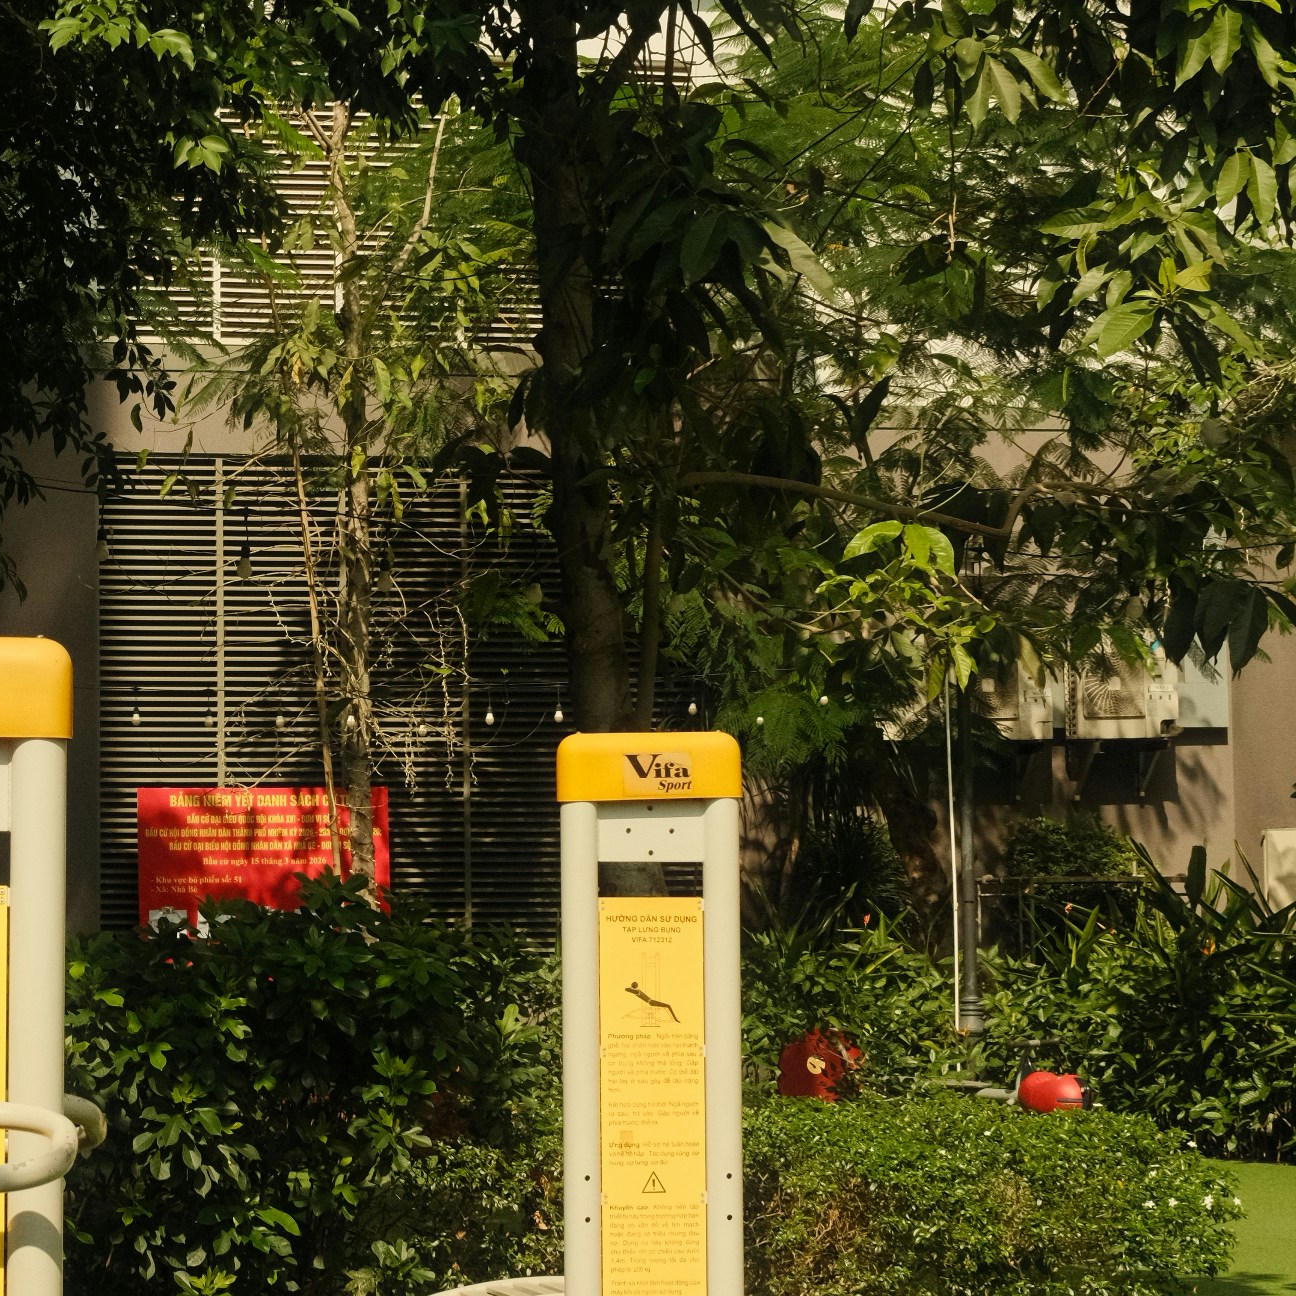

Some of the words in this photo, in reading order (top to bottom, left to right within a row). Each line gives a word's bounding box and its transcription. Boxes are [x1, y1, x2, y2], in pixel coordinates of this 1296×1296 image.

[624, 754, 690, 778] Vifa
[658, 780, 692, 793] Sport
[257, 795, 287, 807] DANH
[250, 857, 260, 865] 15
[261, 856, 283, 868] tháng
[284, 857, 289, 865] 3
[309, 857, 326, 865] 2026
[156, 876, 171, 884] Khu
[234, 876, 242, 884] 51
[606, 913, 638, 923] HƯỚNG
[673, 915, 698, 925] DỤNG
